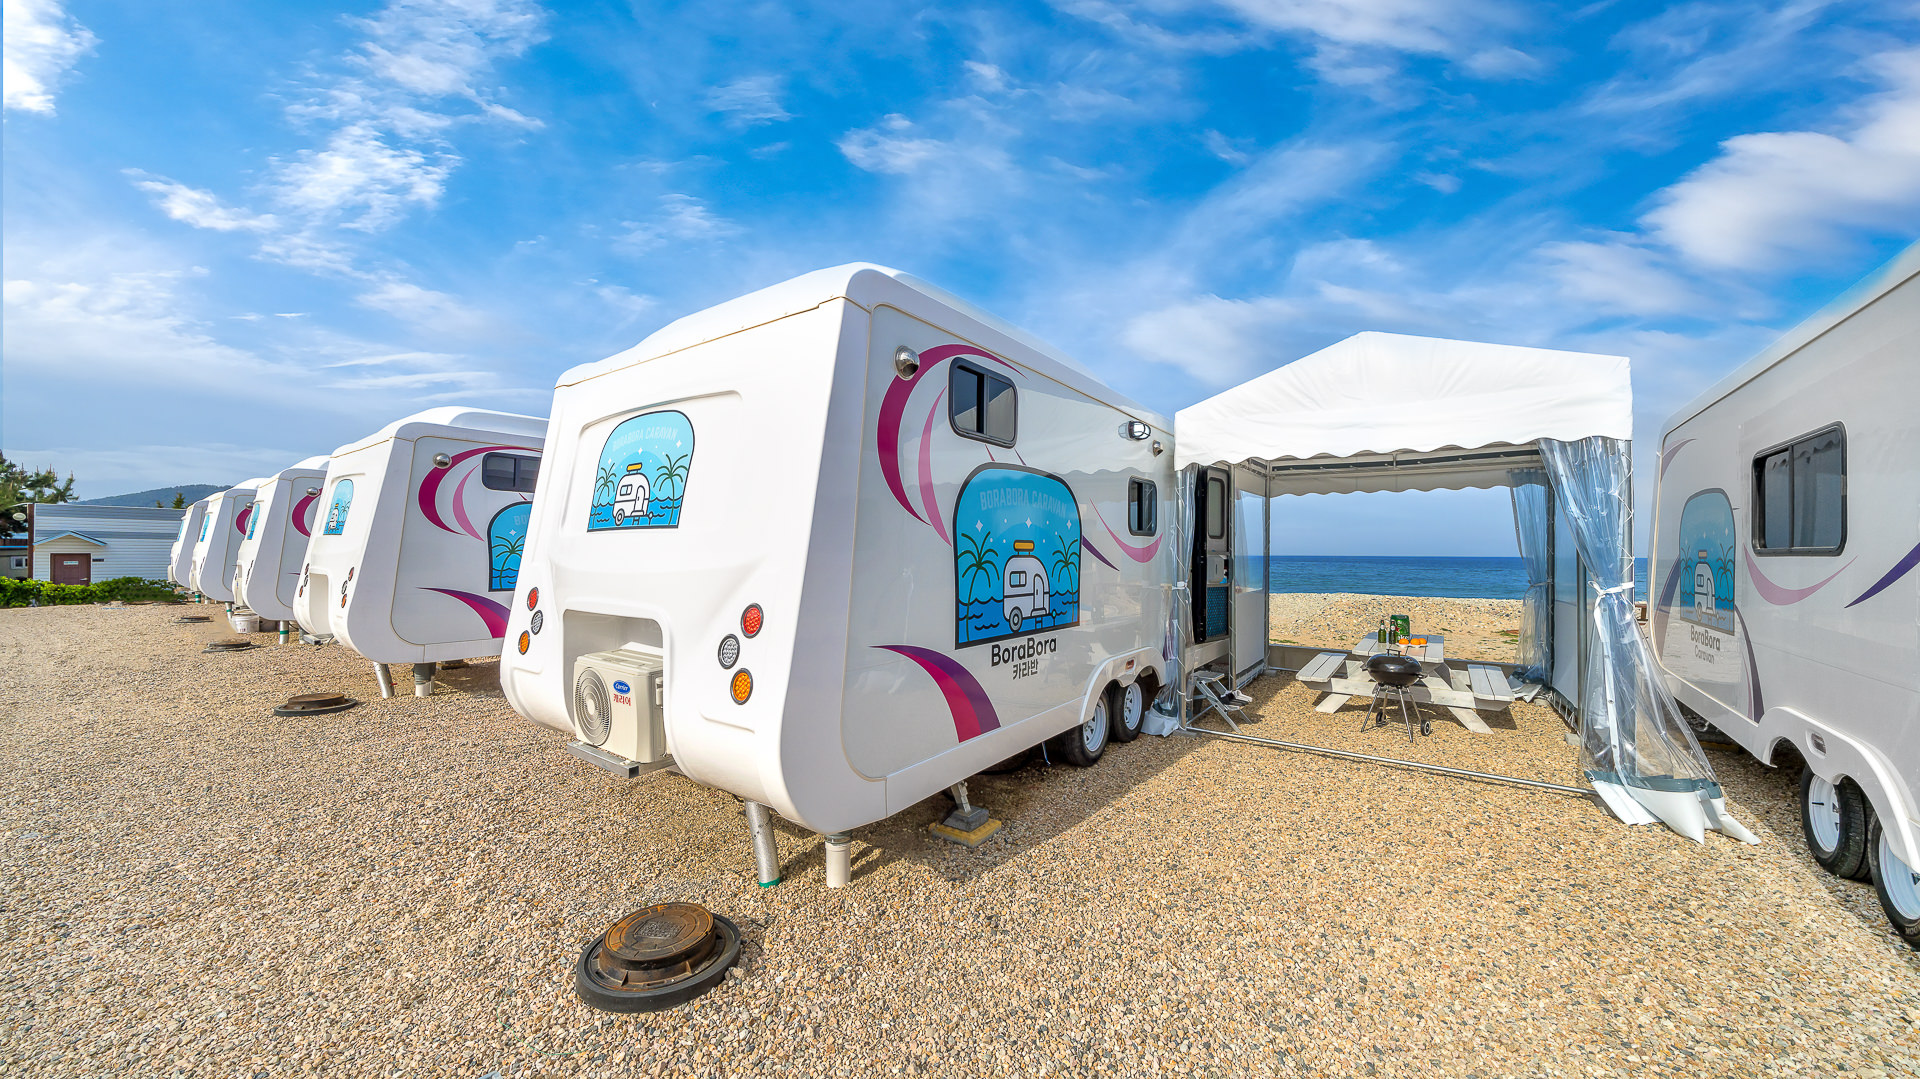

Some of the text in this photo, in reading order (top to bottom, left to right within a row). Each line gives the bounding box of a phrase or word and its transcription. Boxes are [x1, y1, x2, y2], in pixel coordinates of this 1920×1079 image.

[980, 488, 1067, 518] BORABORA CARAVAN
[1691, 624, 1721, 651] BoraBora
[991, 637, 1057, 667] BoraBora
[1695, 644, 1715, 664] Caravan
[1012, 658, 1039, 680] 카라반
